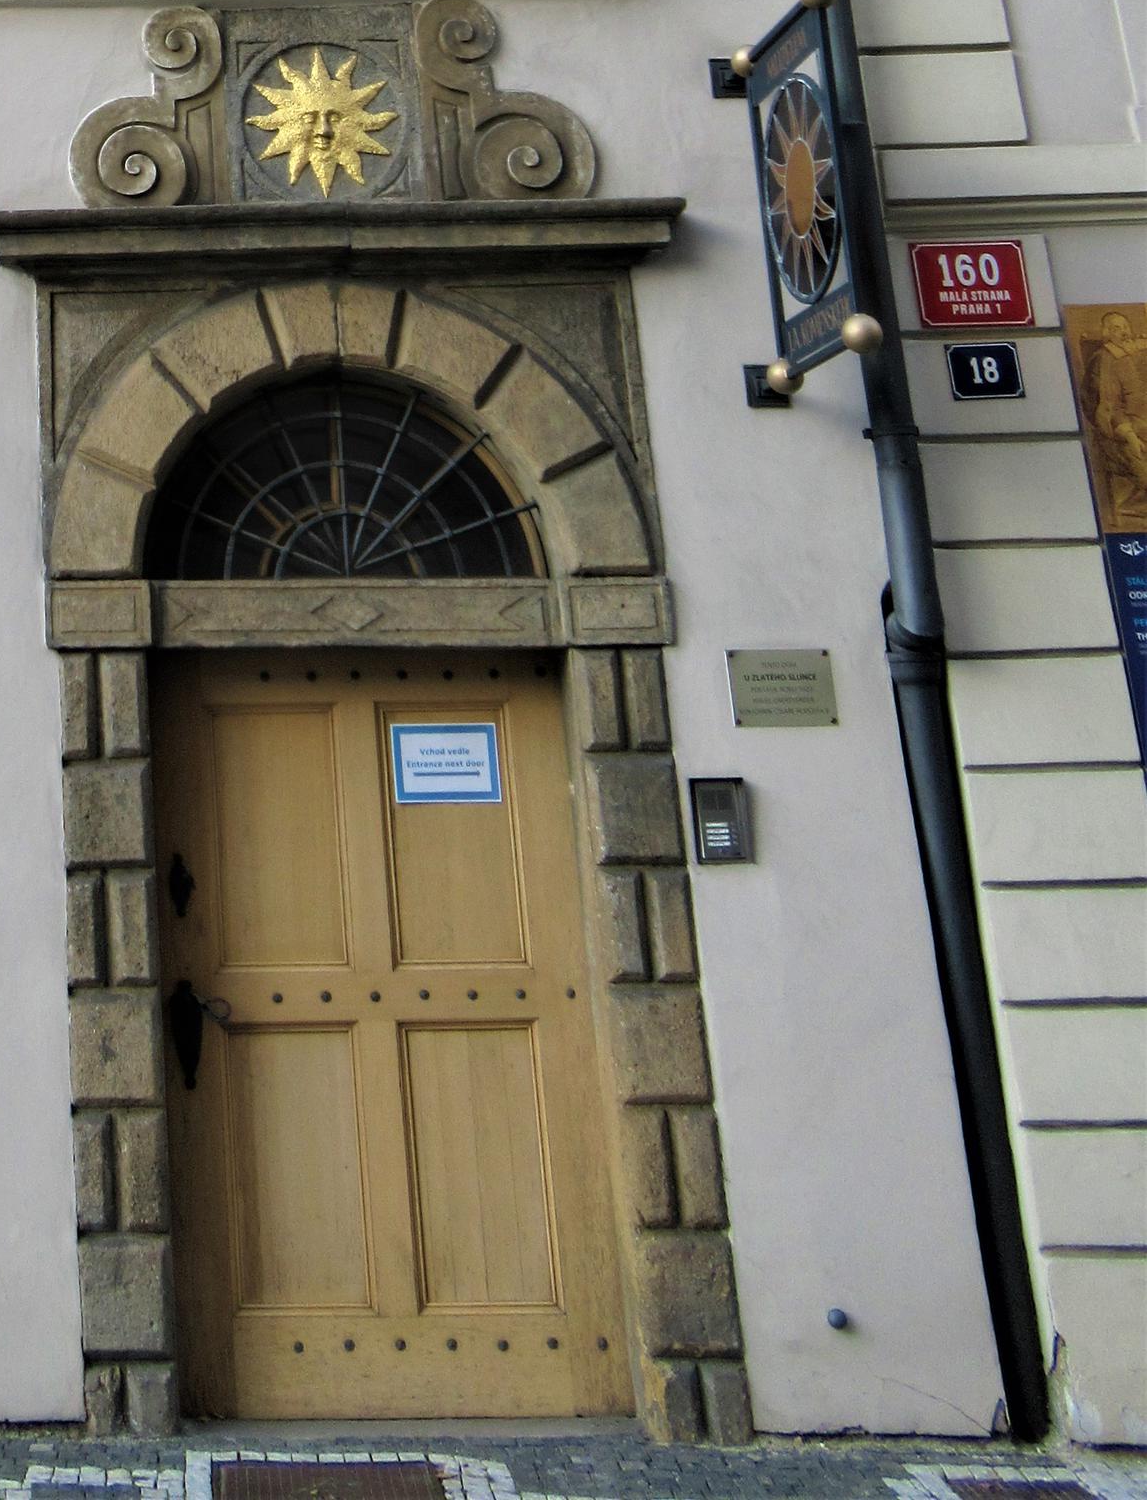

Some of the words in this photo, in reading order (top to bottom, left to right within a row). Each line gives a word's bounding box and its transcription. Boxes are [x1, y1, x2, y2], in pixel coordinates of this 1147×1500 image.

[937, 252, 1001, 288] 160
[939, 288, 969, 303] MALÁ
[971, 290, 1012, 302] STRANA
[952, 303, 992, 316] PRAHA
[996, 303, 1002, 315] 1
[969, 356, 1001, 385] 18
[447, 747, 470, 755] vedle
[406, 760, 443, 768] Entrance
[445, 760, 463, 768] next
[465, 759, 485, 767] door
